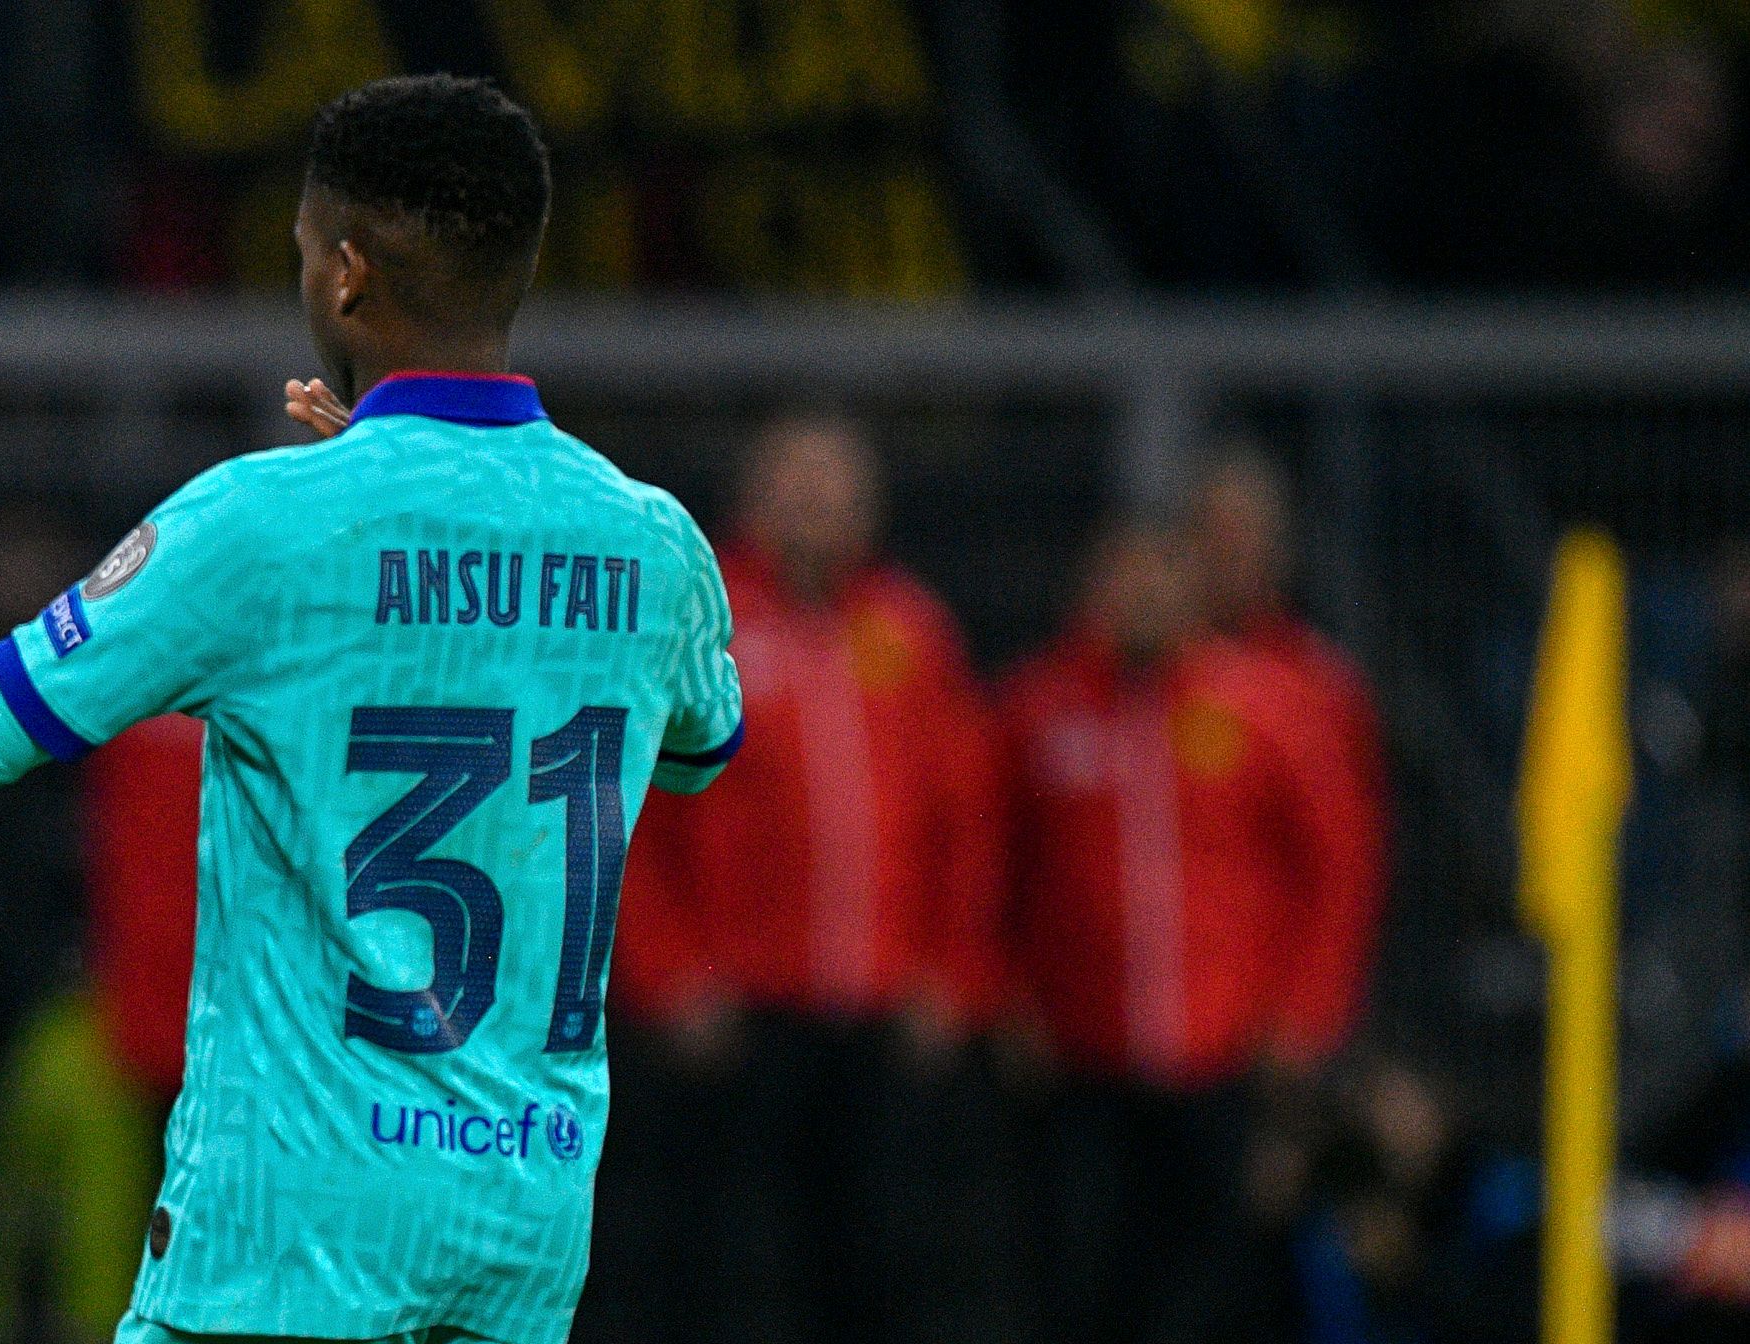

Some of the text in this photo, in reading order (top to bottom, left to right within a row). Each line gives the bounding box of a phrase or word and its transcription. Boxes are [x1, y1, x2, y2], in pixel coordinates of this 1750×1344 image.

[375, 549, 640, 633] ANSU FATI
[344, 706, 629, 1054] 31
[372, 1100, 540, 1159] unicef
